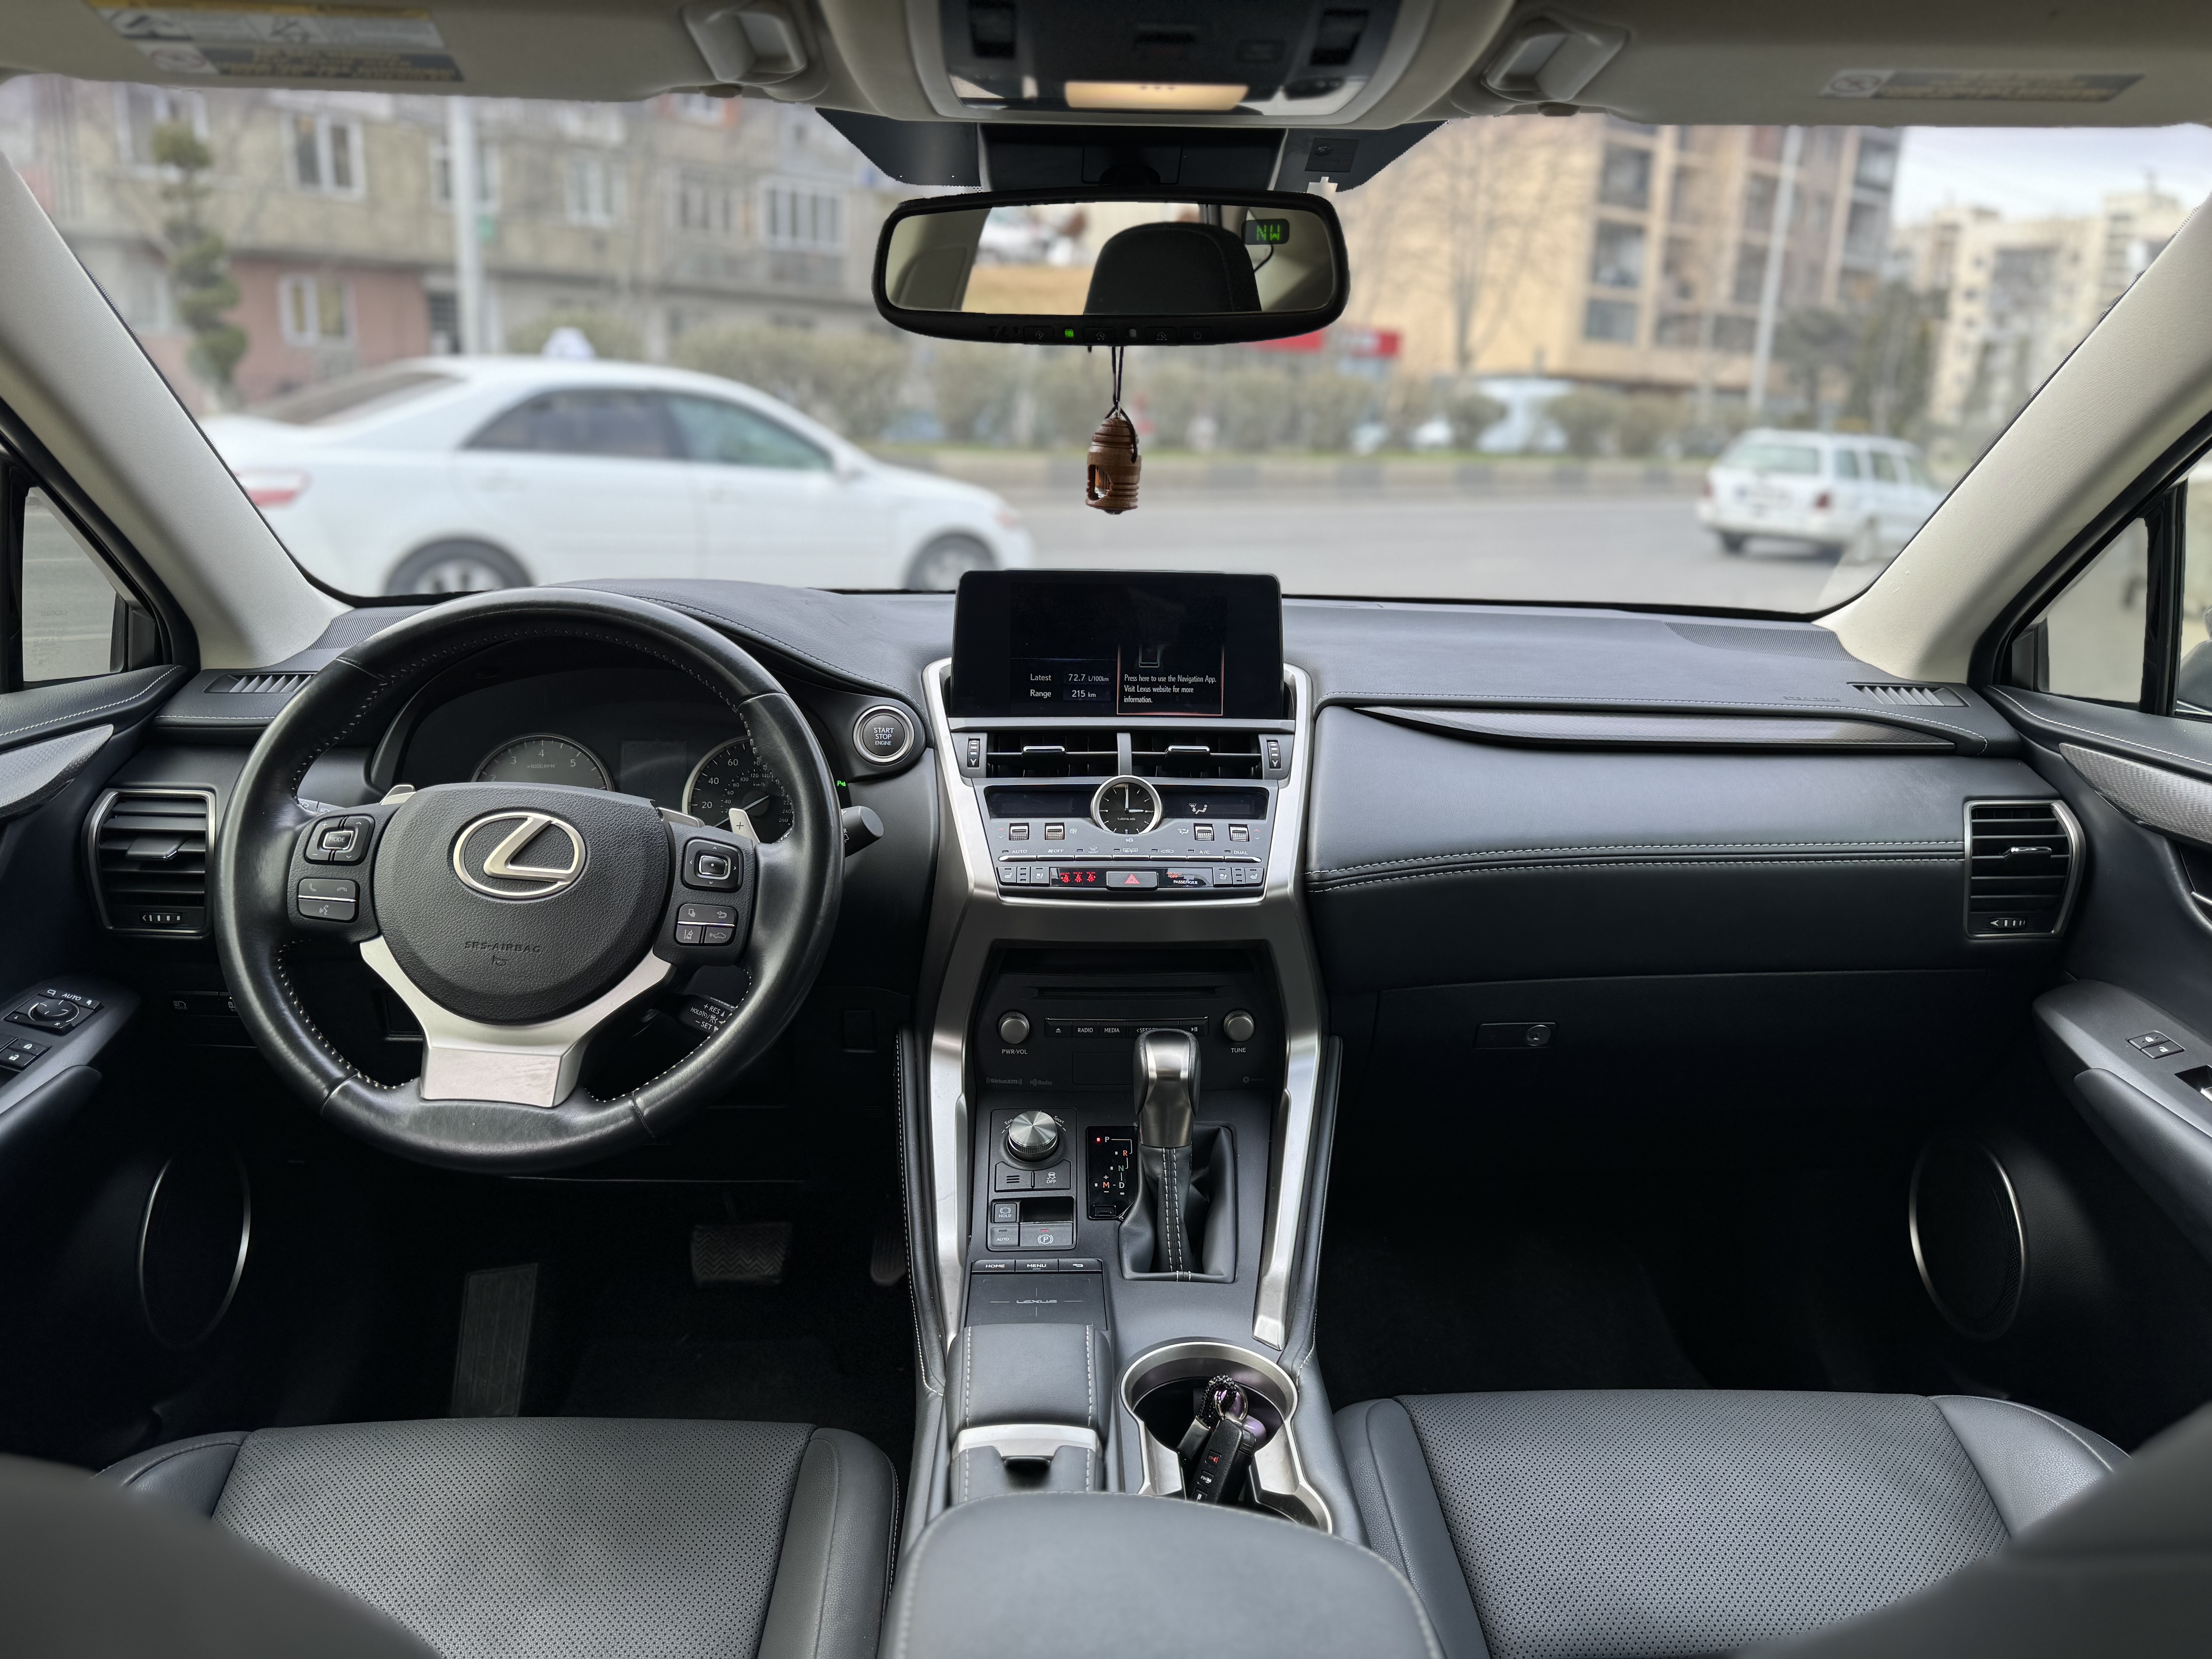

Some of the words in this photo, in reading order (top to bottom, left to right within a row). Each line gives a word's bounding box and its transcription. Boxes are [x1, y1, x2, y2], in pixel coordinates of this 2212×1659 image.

[1257, 224, 1280, 241] NW
[1178, 675, 1203, 683] Navigation
[1205, 675, 1217, 684] App.
[1030, 689, 1051, 698] Range
[690, 1007, 702, 1016] HOLD
[709, 1006, 721, 1014] RES
[701, 1021, 713, 1030] SET
[1053, 1116, 1064, 1124] Sport
